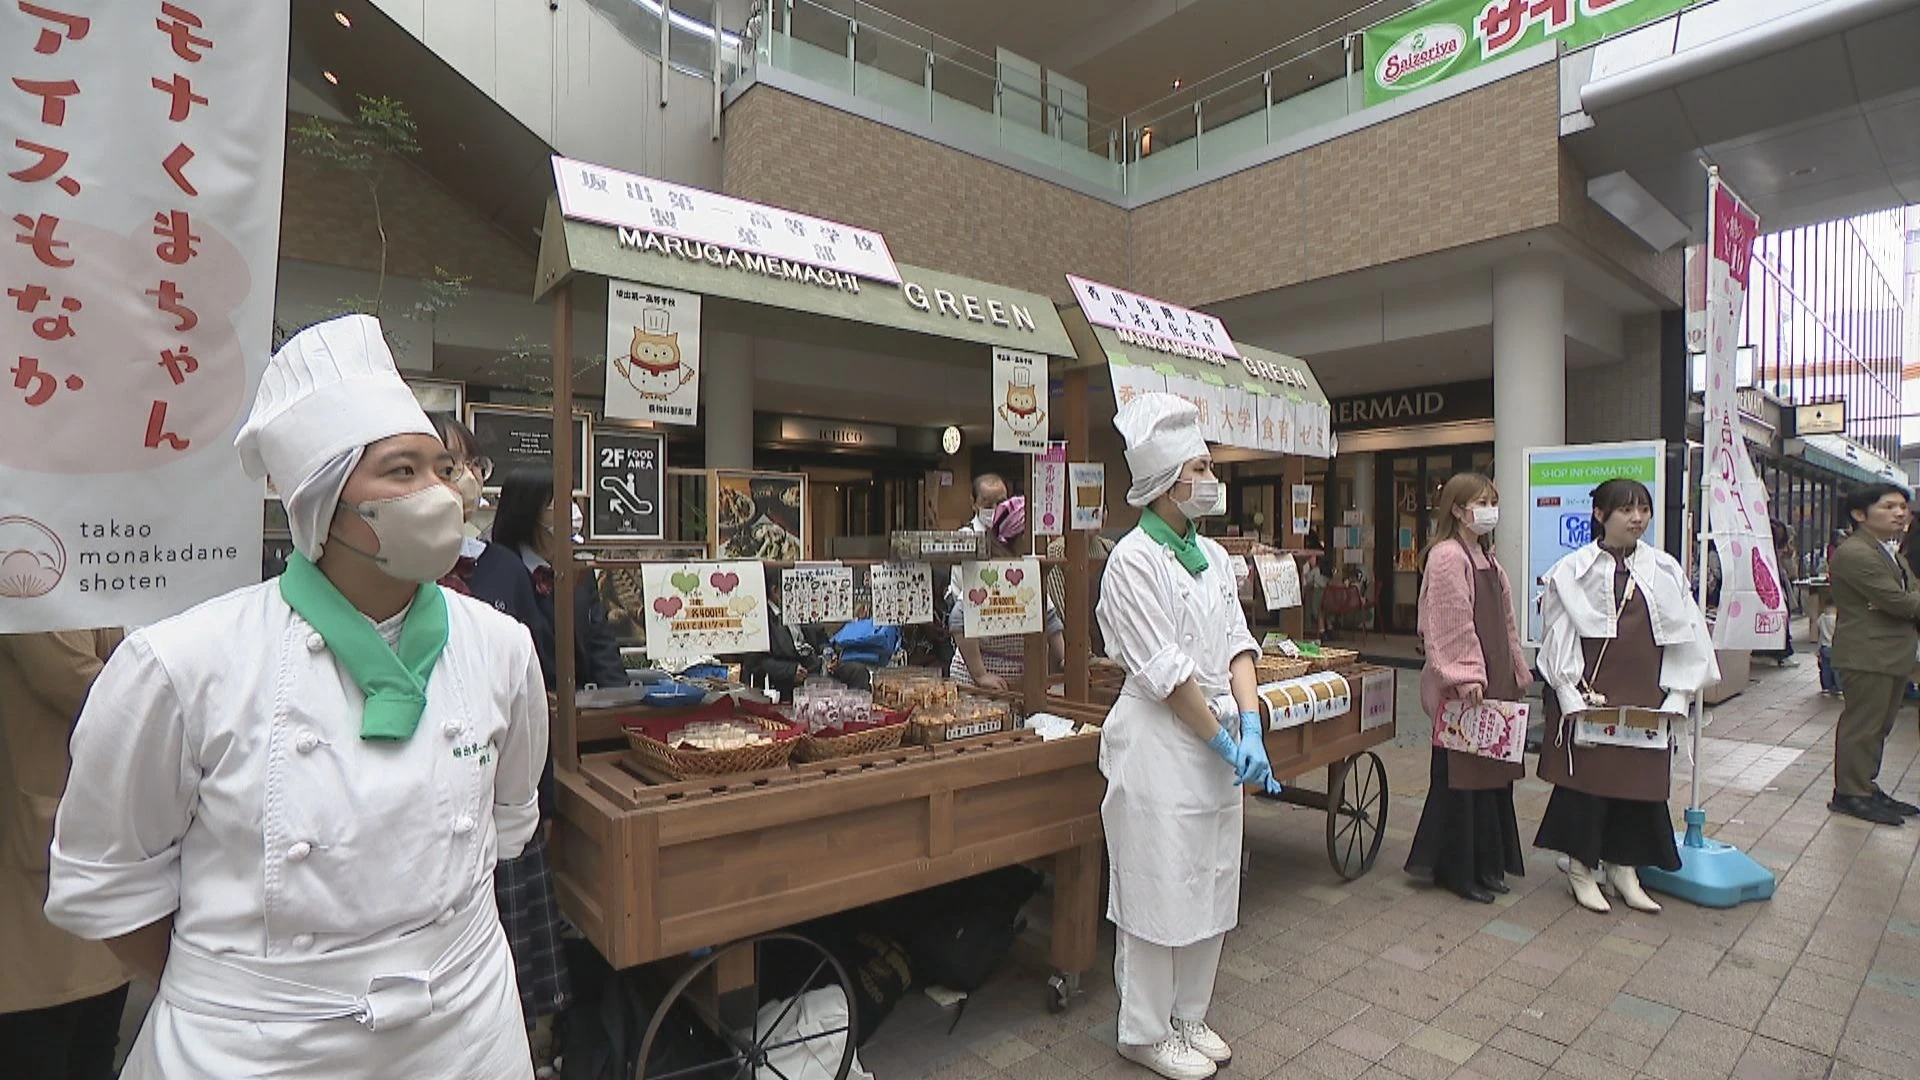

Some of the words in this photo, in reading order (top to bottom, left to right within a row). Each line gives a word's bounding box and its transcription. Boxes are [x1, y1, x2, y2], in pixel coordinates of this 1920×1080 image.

[1476, 0, 1625, 54] サイ
[1384, 39, 1457, 80] Saizeriya
[8, 0, 89, 407] アイスもなか
[145, 1, 213, 450] モナくまちゃん
[617, 226, 860, 293] MARUGAMEMACHI
[904, 282, 1036, 332] GREEN
[1115, 327, 1226, 367] MARUGAMEMACHI
[1242, 356, 1308, 389] GREEN
[601, 448, 624, 468] 2F
[627, 449, 653, 460] FOOD
[627, 460, 653, 470] AREA
[1541, 468, 1568, 478] SHOP
[1570, 465, 1643, 478] INFORMATION
[80, 519, 151, 537] takao
[80, 544, 237, 565] monakadane
[80, 573, 167, 592] shoten
